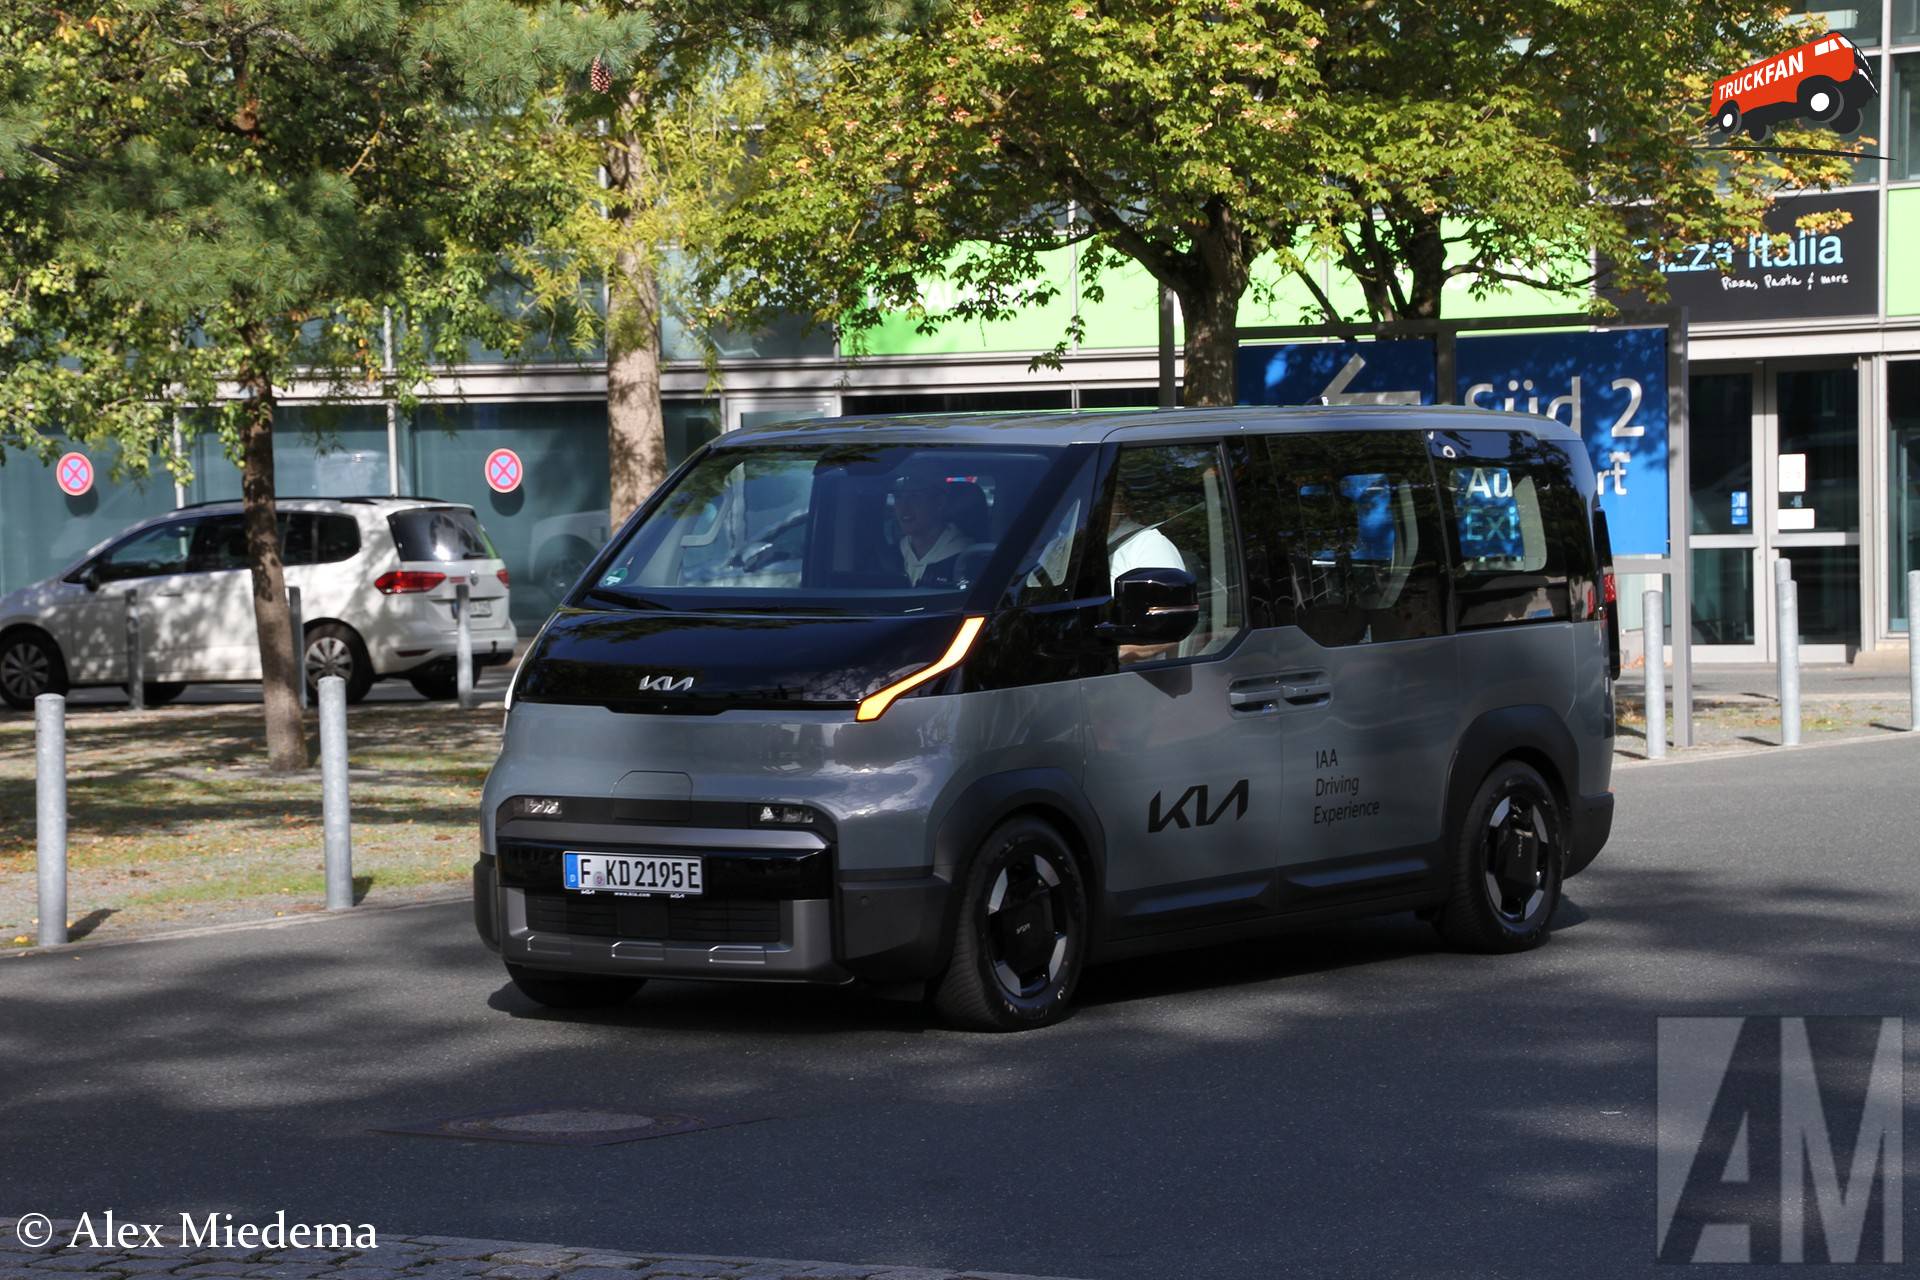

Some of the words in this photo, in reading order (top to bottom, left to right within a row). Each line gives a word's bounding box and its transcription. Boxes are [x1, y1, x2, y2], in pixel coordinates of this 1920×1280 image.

[1749, 229, 1843, 268] Italia
[1764, 274, 1802, 288] Pasta
[1820, 274, 1849, 284] more
[1611, 378, 1645, 437] 2
[1466, 506, 1518, 541] Exi
[639, 675, 694, 691] KIA
[1315, 749, 1338, 768] IAA
[1315, 775, 1359, 797] Driving
[1148, 779, 1249, 833] KIA
[1313, 801, 1379, 826] Experience
